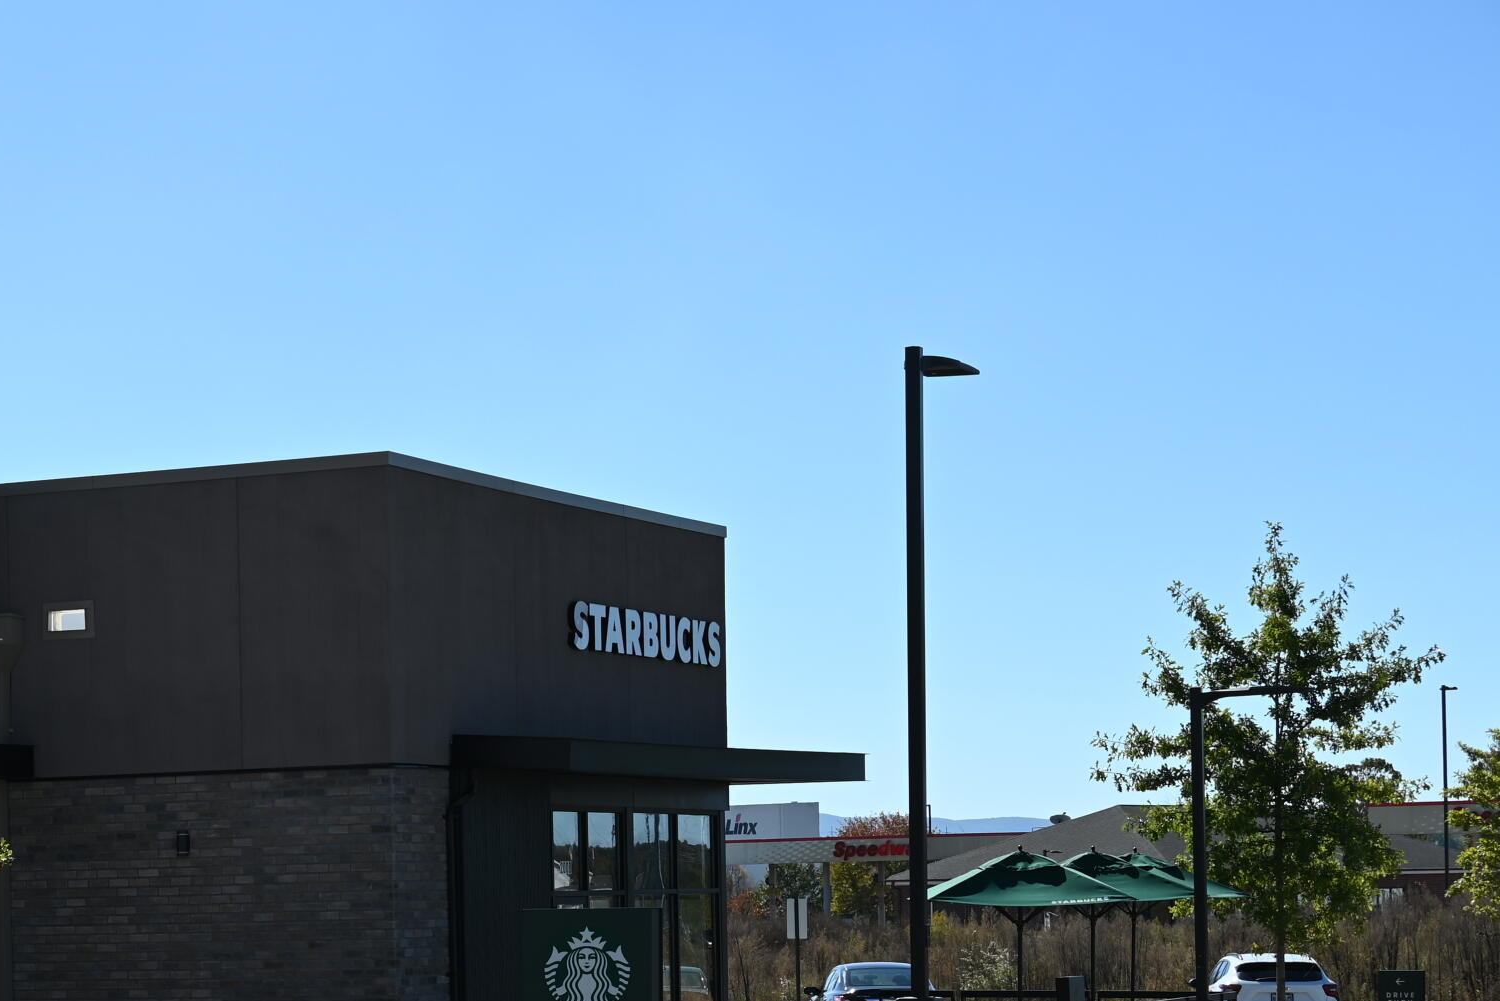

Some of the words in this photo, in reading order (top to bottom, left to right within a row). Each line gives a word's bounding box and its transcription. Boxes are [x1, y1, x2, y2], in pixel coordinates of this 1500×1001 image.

[572, 600, 722, 668] STARBUCKS
[725, 813, 758, 835] Linx
[833, 840, 914, 861] Speedw
